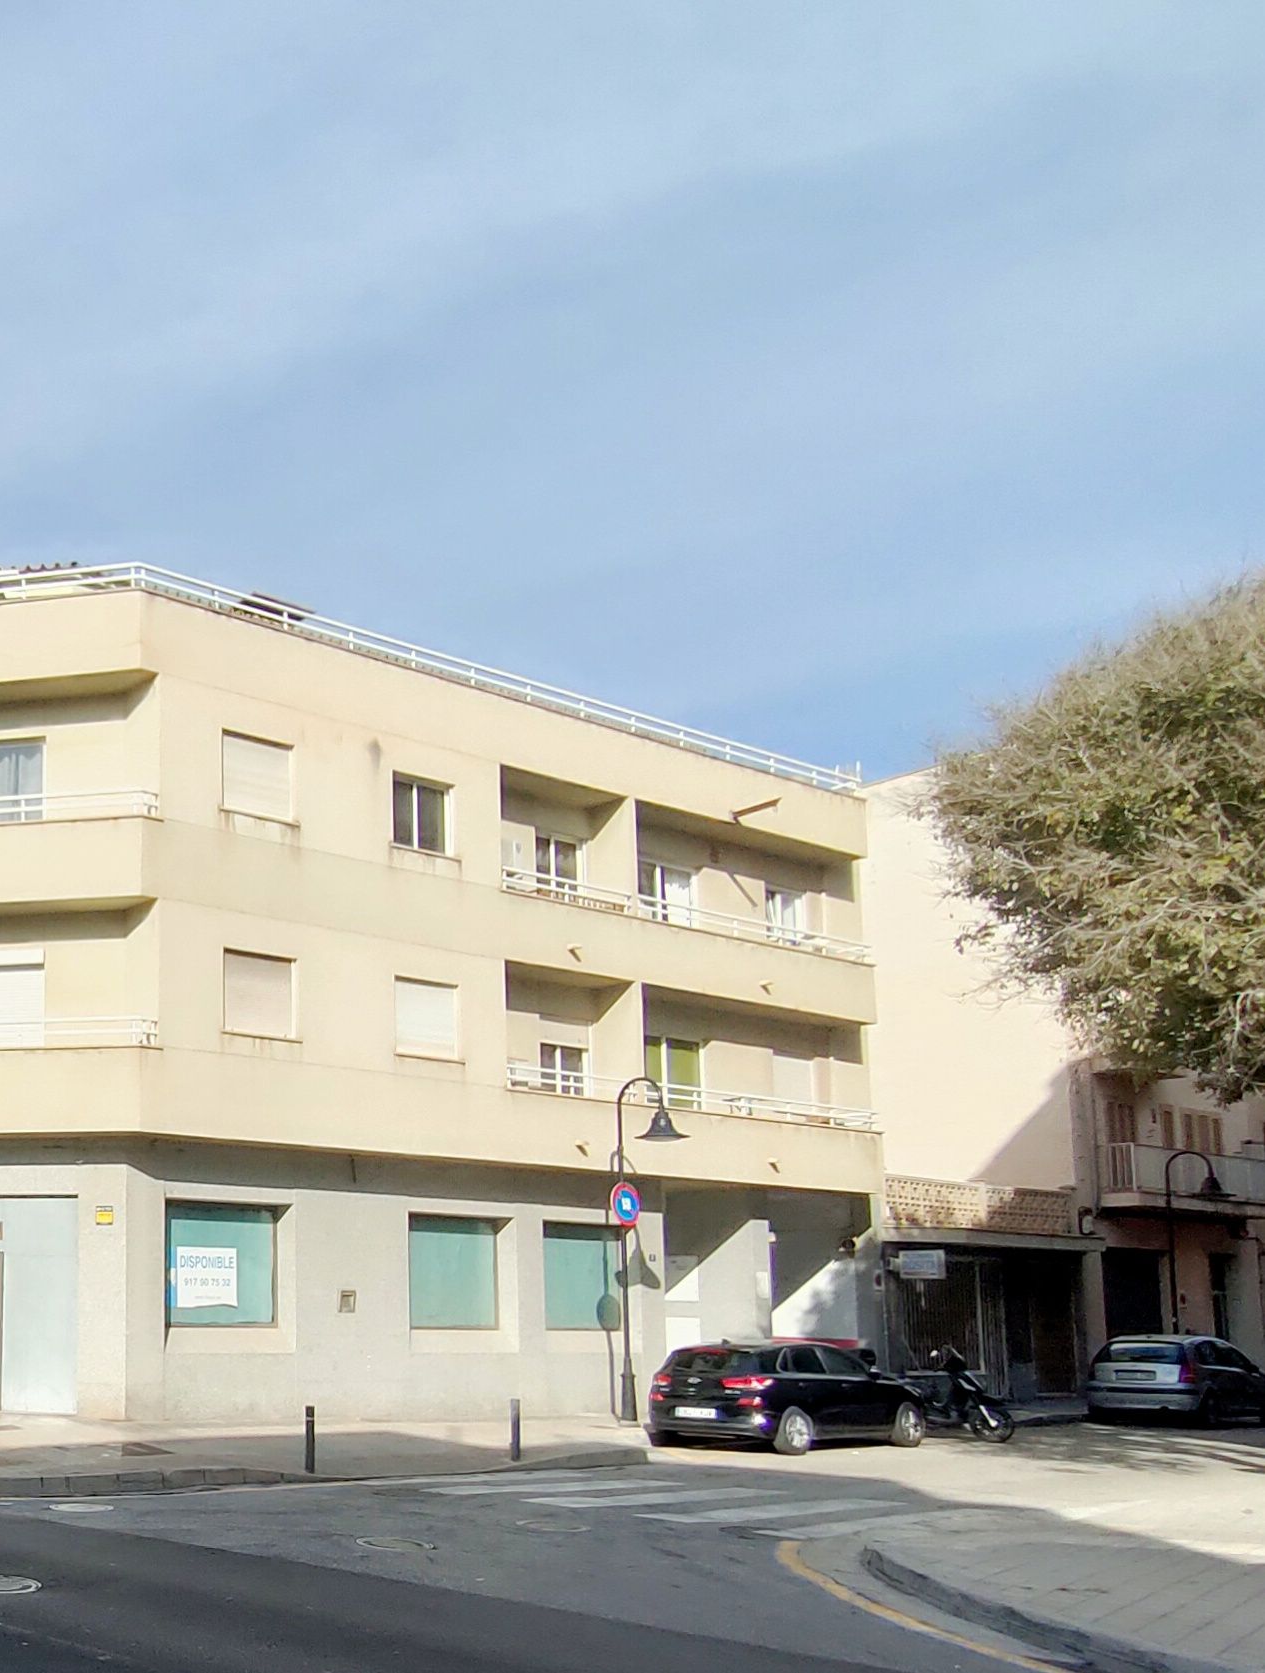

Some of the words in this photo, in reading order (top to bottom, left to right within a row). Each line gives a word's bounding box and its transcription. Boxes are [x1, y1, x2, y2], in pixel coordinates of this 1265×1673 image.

[180, 1255, 235, 1269] DISPONIBLE
[184, 1278, 197, 1286] 917
[211, 1278, 220, 1287] 75
